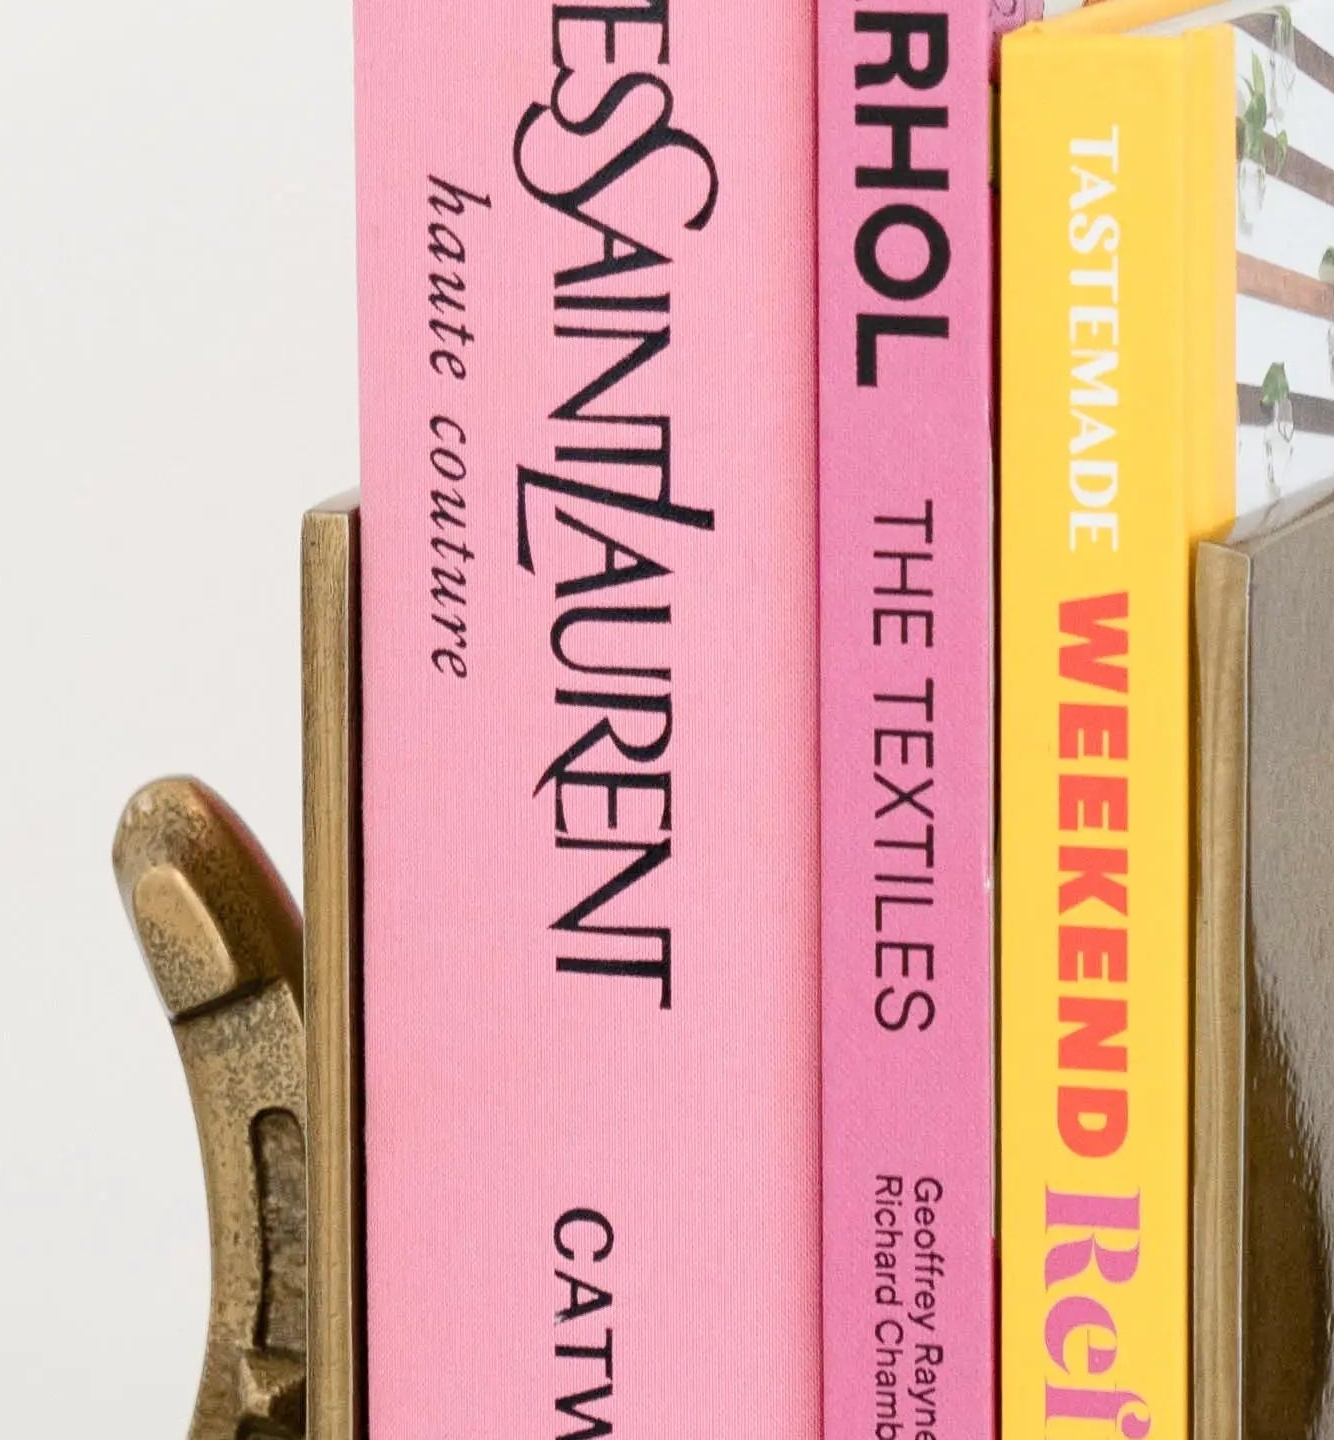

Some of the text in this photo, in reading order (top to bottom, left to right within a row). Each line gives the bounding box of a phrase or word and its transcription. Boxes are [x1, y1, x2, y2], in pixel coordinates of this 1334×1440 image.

[427, 173, 492, 679] haute couture
[1068, 123, 1120, 551] TASTEMADE
[516, 463, 716, 1010] LAURENT
[872, 498, 936, 1032] THE TEXTILES
[1056, 591, 1130, 1159] WEEKEND
[873, 1174, 904, 1307] Richard
[906, 1176, 945, 1333] Geoffrey
